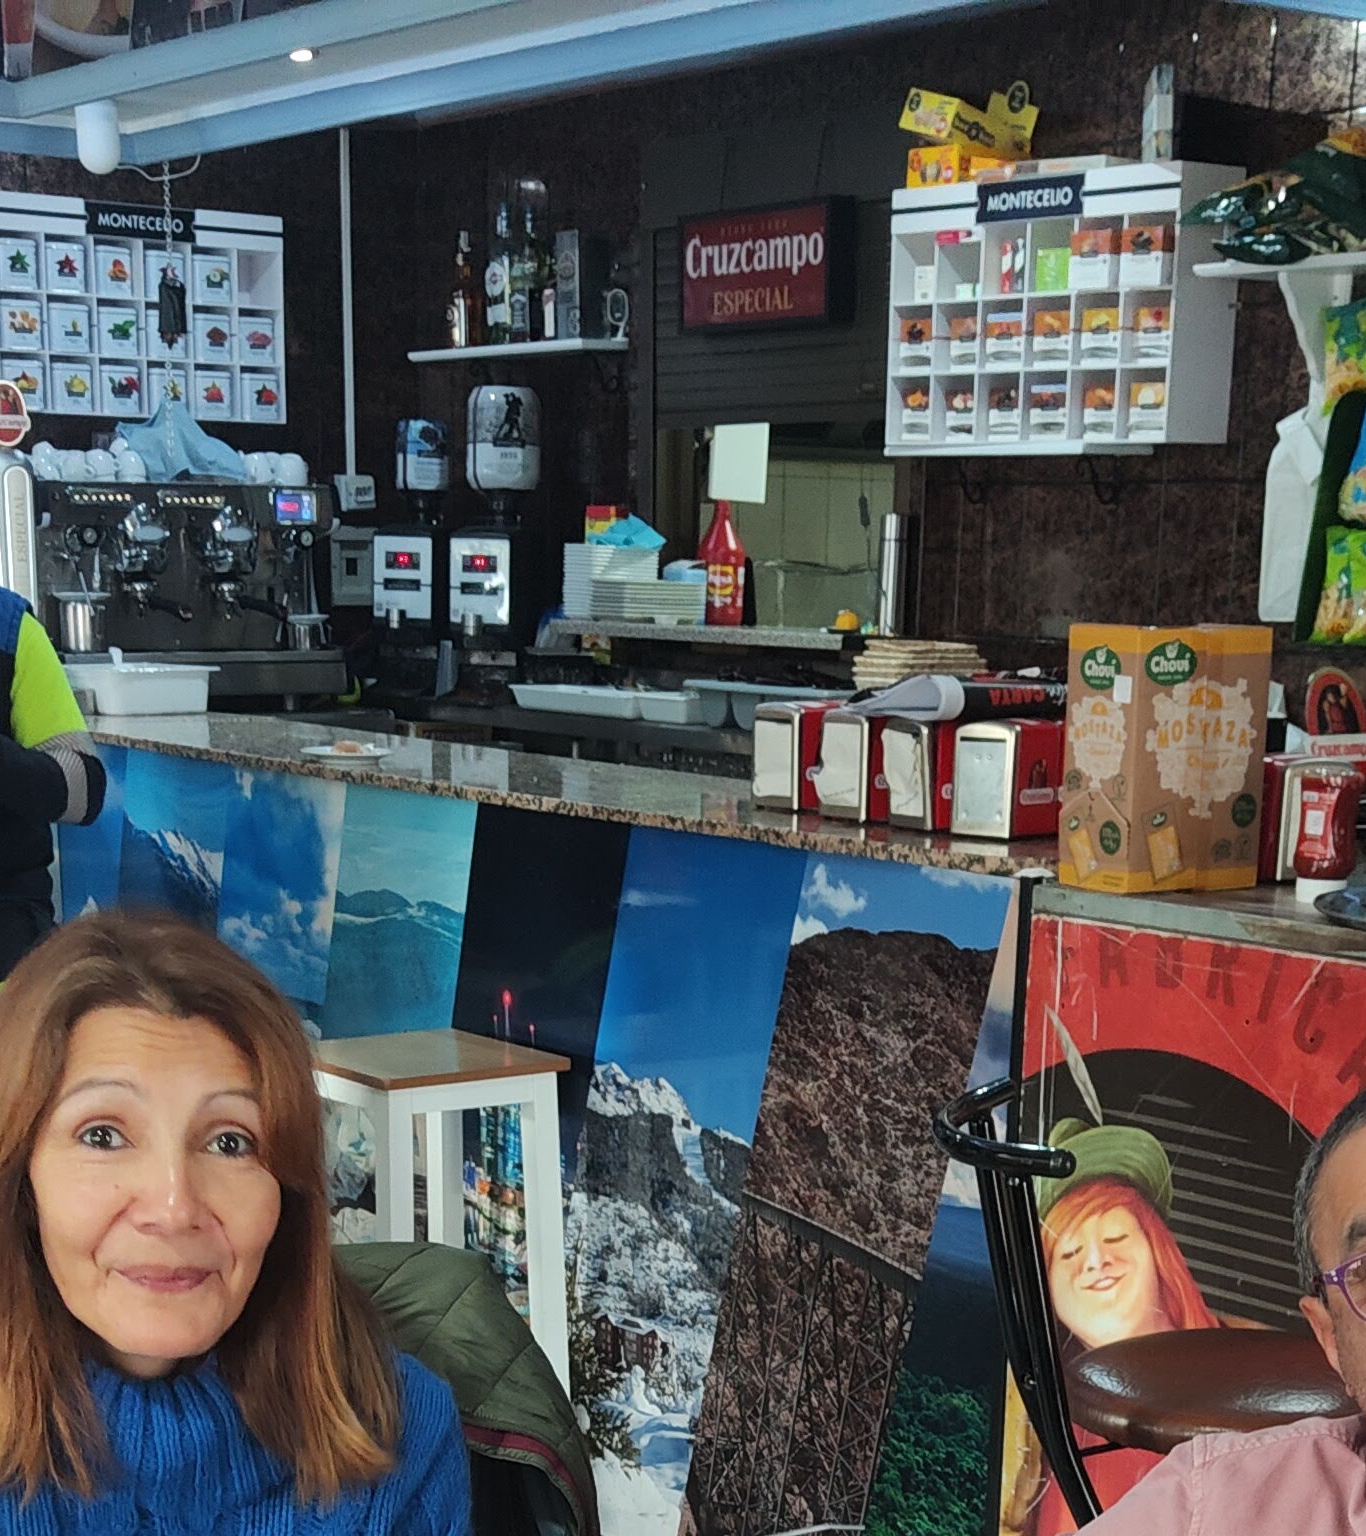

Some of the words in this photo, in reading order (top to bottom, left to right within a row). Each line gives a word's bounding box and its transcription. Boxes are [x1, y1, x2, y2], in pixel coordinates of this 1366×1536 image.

[686, 232, 824, 279] Cruzcampo
[713, 286, 793, 316] ESPECIAL
[989, 687, 1045, 706] CARTA
[1156, 712, 1250, 749] MOSTAZA
